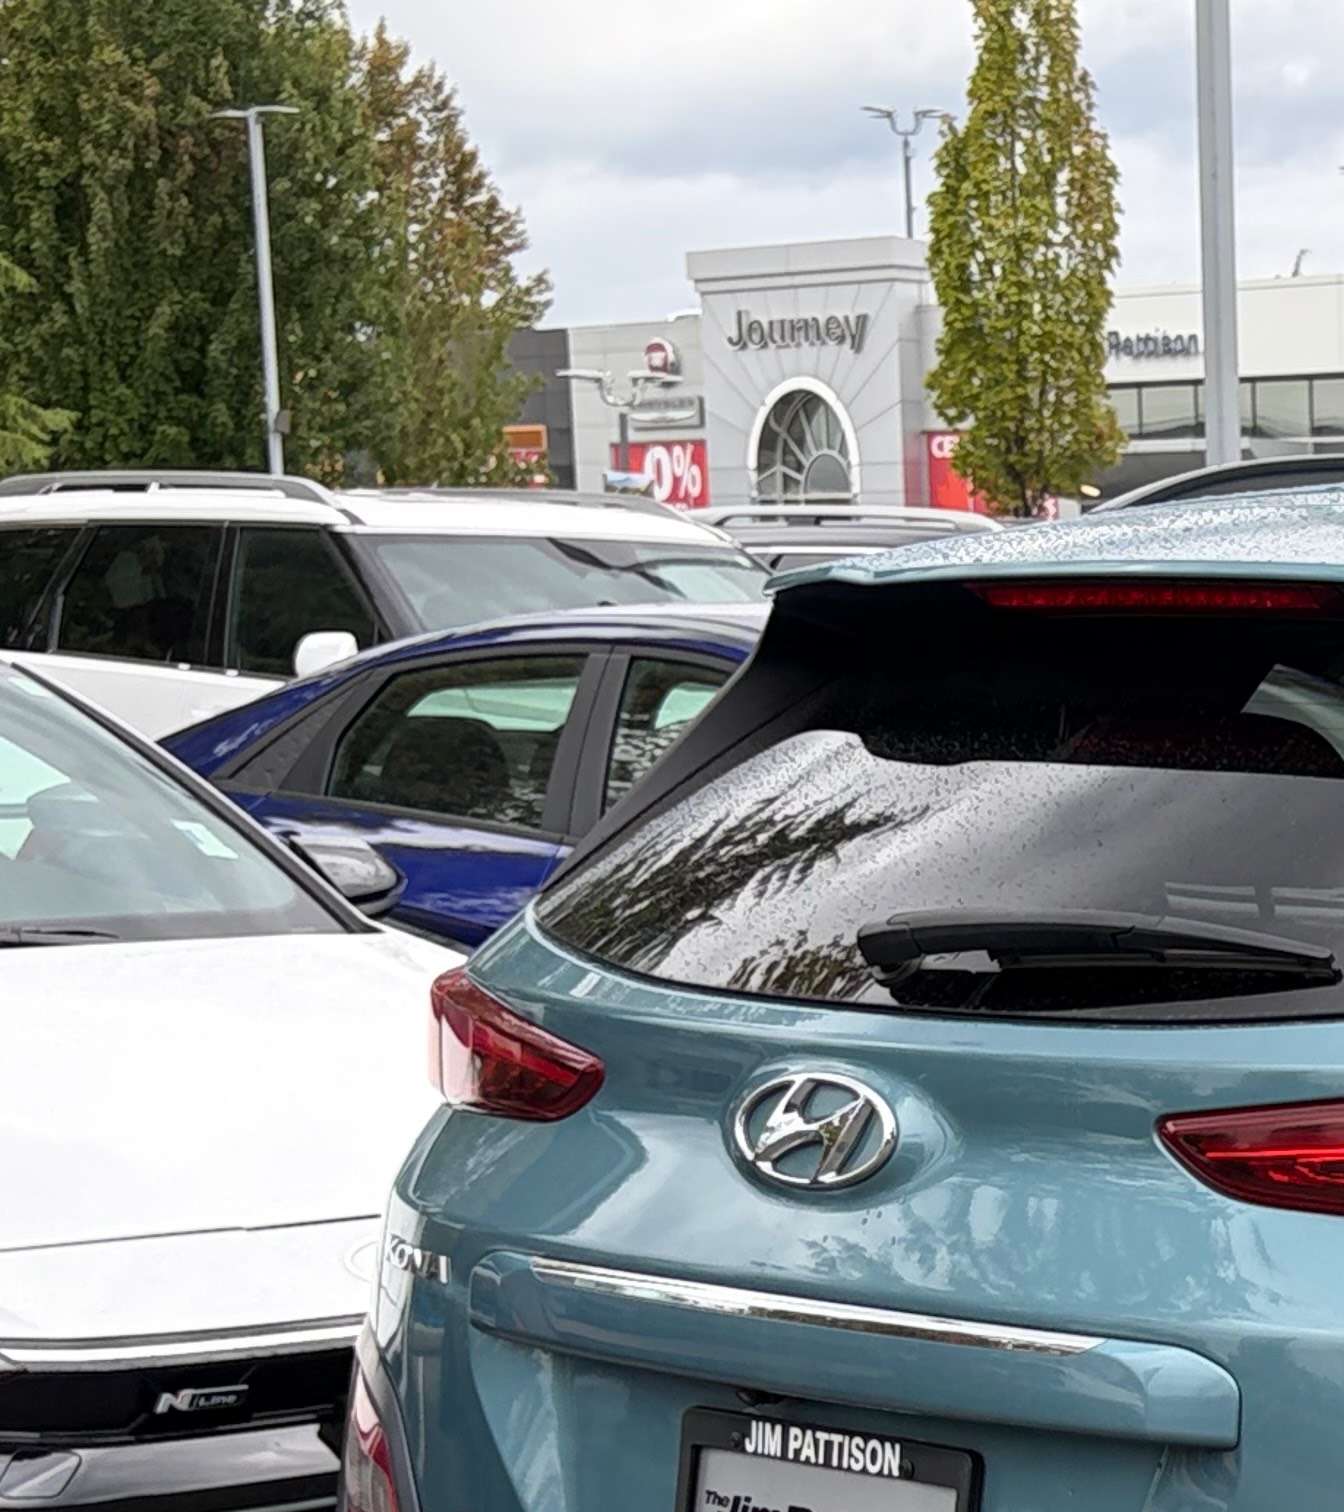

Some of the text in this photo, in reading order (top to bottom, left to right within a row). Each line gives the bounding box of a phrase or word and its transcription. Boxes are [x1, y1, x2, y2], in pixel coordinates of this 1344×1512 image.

[727, 309, 869, 353] Journey
[745, 1420, 901, 1477] JIM PATTISON
[705, 1489, 730, 1508] The
